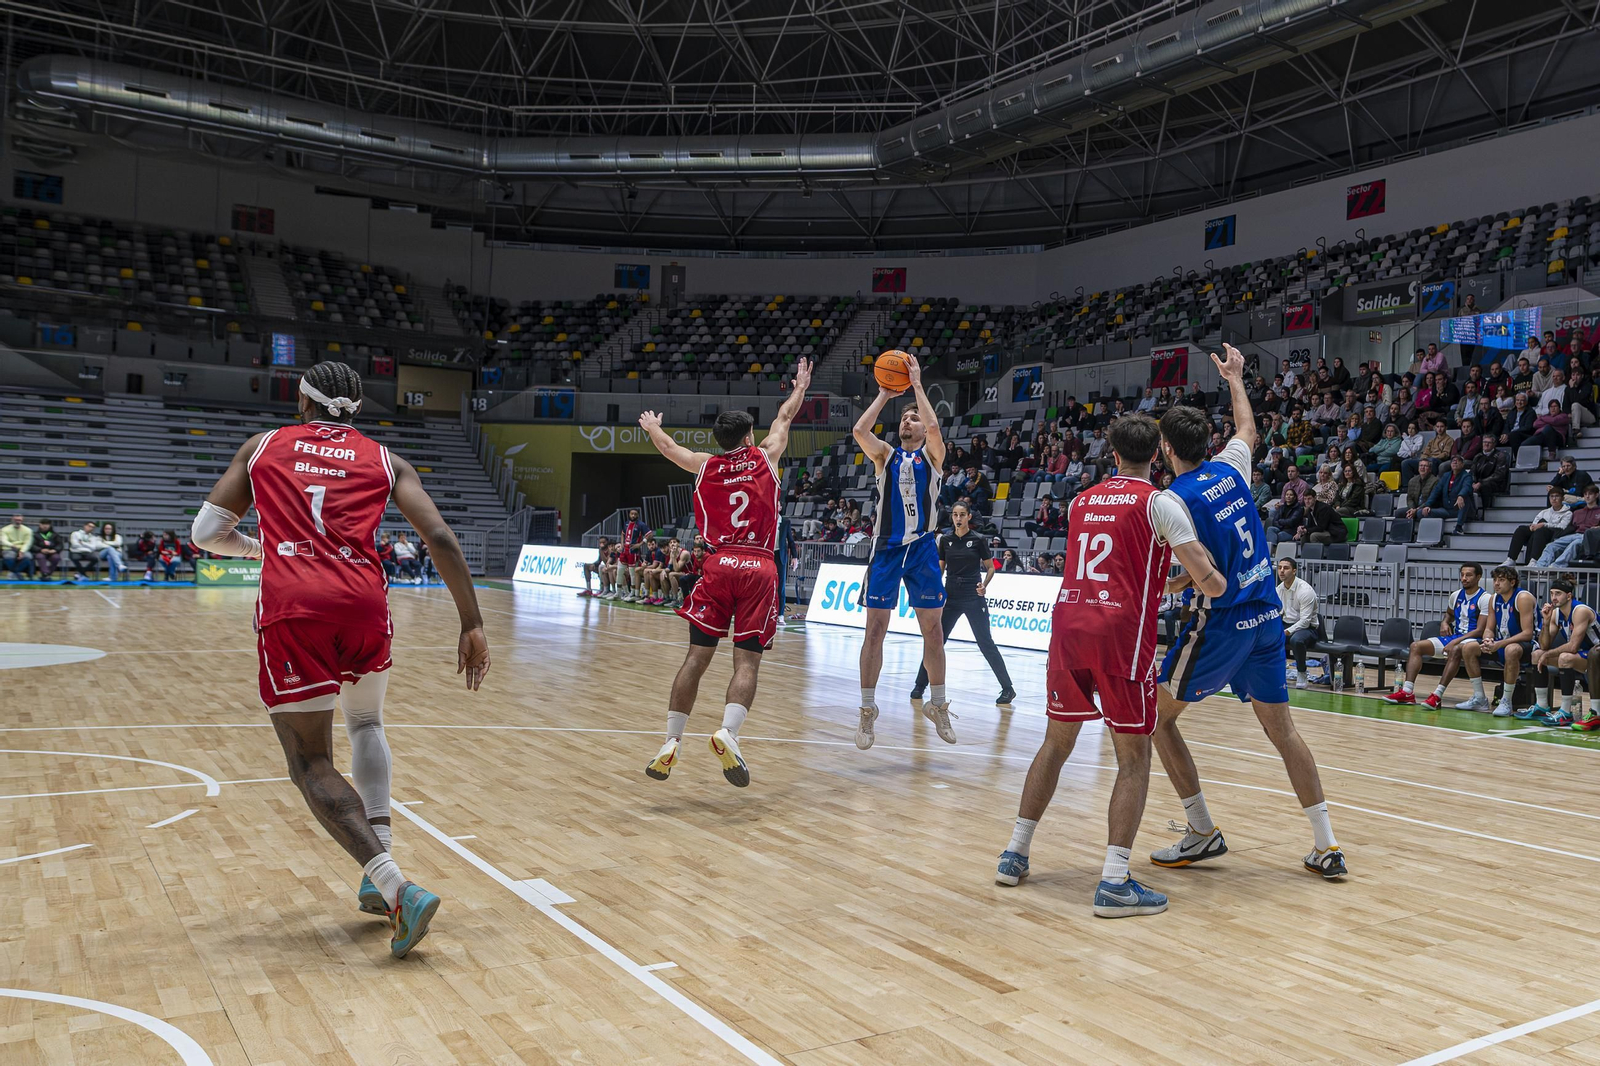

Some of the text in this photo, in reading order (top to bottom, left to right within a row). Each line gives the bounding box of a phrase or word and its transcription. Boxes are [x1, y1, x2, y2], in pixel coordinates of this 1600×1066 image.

[1347, 184, 1372, 196] Sector
[1347, 180, 1386, 221] 22
[1205, 219, 1226, 229] Sector
[1206, 215, 1236, 250] 21
[621, 265, 650, 289] 19
[873, 268, 907, 292] 20
[1422, 285, 1443, 293] Sector
[1422, 281, 1455, 313] 23
[1285, 305, 1304, 314] Sector
[1357, 293, 1400, 312] Salida
[1286, 304, 1313, 331] 22
[1556, 315, 1599, 330] Sector
[408, 348, 447, 363] Salida
[1151, 350, 1175, 361] Sector
[957, 358, 979, 371] Salida
[1151, 347, 1189, 389] 22
[1012, 370, 1032, 378] Sector
[984, 387, 998, 403] 22
[1031, 382, 1045, 398] 22
[406, 392, 424, 406] 18
[471, 397, 487, 411] 18
[540, 389, 574, 418] 19
[294, 440, 356, 461] FELIZOR
[294, 462, 347, 478] Blanca
[1202, 476, 1237, 502] TREVIÑO
[1088, 493, 1138, 505] BALDERAS
[304, 485, 327, 537] 1
[729, 491, 750, 528] 2
[905, 503, 916, 517] 16
[1084, 512, 1116, 522] Blanca
[1214, 497, 1248, 522] REDYTEL
[1234, 516, 1255, 559] 5
[1075, 532, 1113, 582] 12
[228, 567, 248, 575] CAJA
[520, 554, 564, 577] SICNOVA
[1016, 600, 1035, 612] SER
[1037, 602, 1050, 613] TU
[1236, 618, 1259, 631] CAJA
